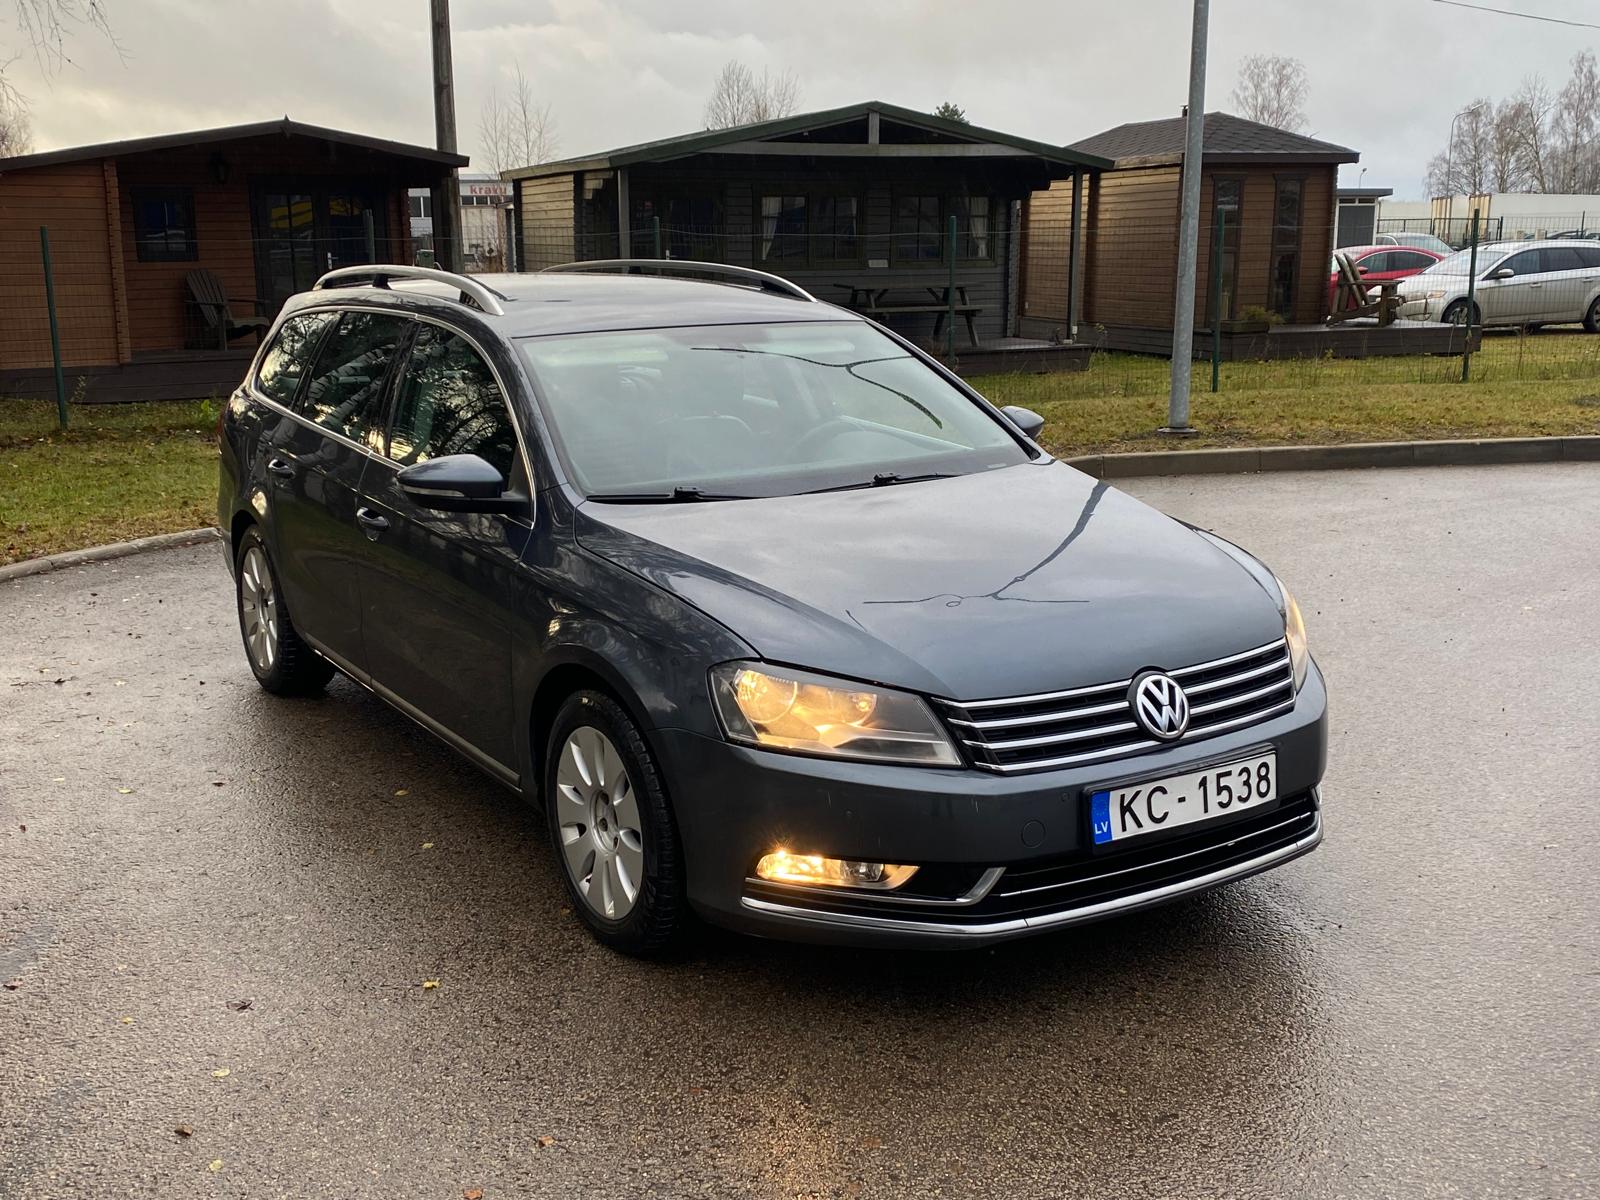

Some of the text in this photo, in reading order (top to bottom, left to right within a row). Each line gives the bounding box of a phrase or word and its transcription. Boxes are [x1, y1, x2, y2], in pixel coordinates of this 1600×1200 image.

[1138, 675, 1188, 736] VW
[1119, 761, 1271, 832] KC-1538
[1094, 821, 1109, 835] LV
